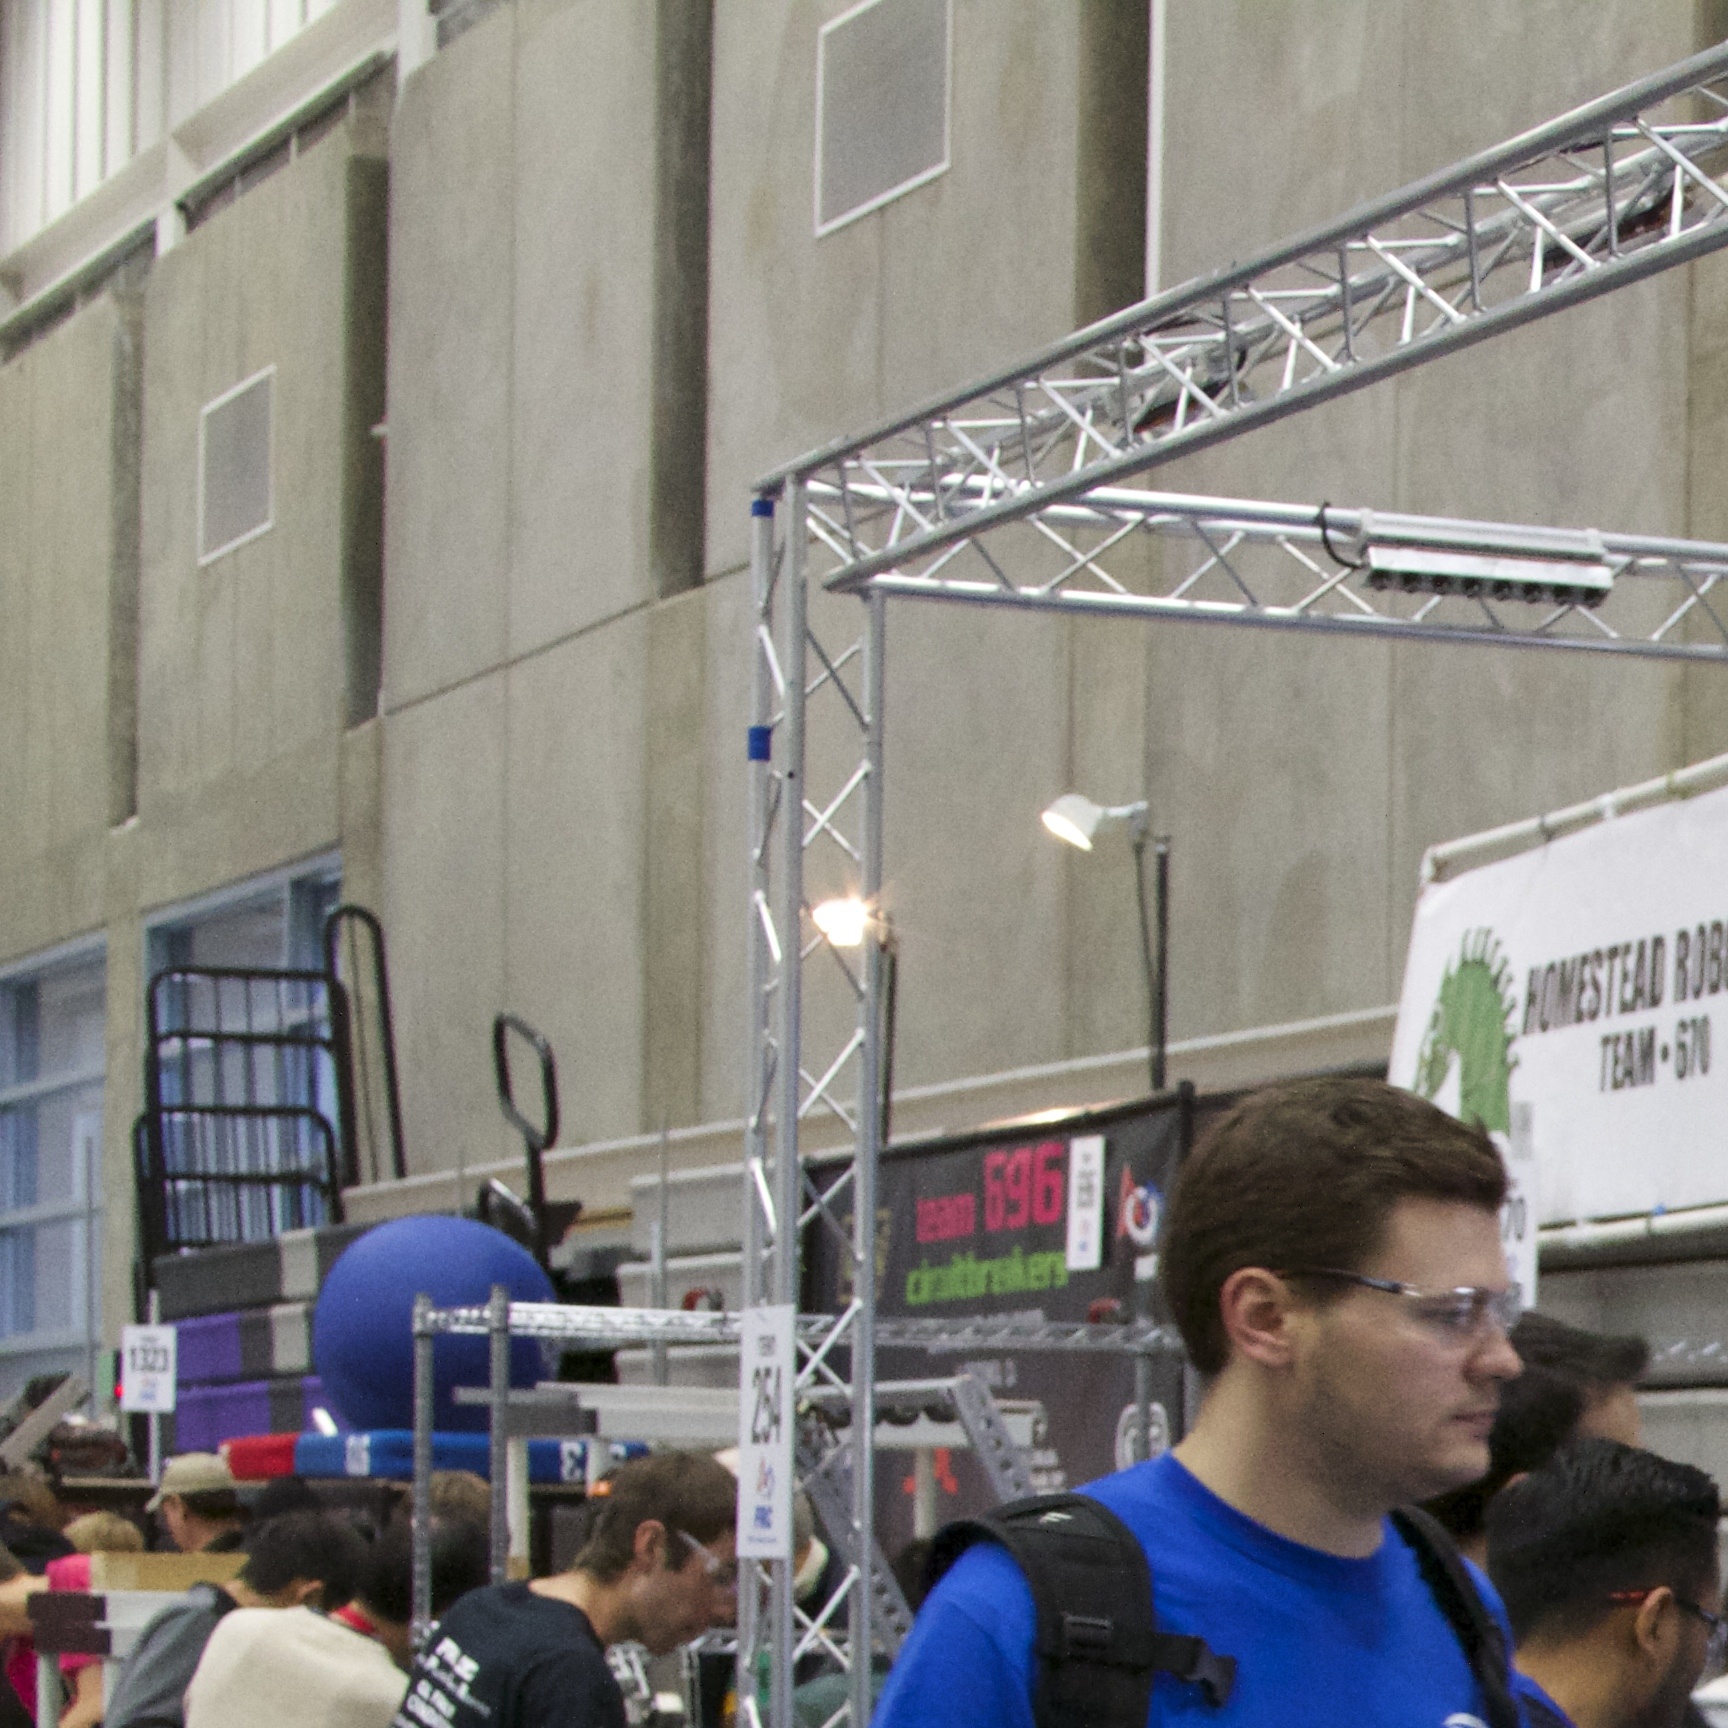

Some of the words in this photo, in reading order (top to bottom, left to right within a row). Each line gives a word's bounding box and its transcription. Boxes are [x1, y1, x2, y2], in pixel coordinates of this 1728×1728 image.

[1522, 934, 1666, 1035] HOMESTEAD
[1600, 1026, 1655, 1092] TEAM
[983, 1141, 1064, 1232] 696
